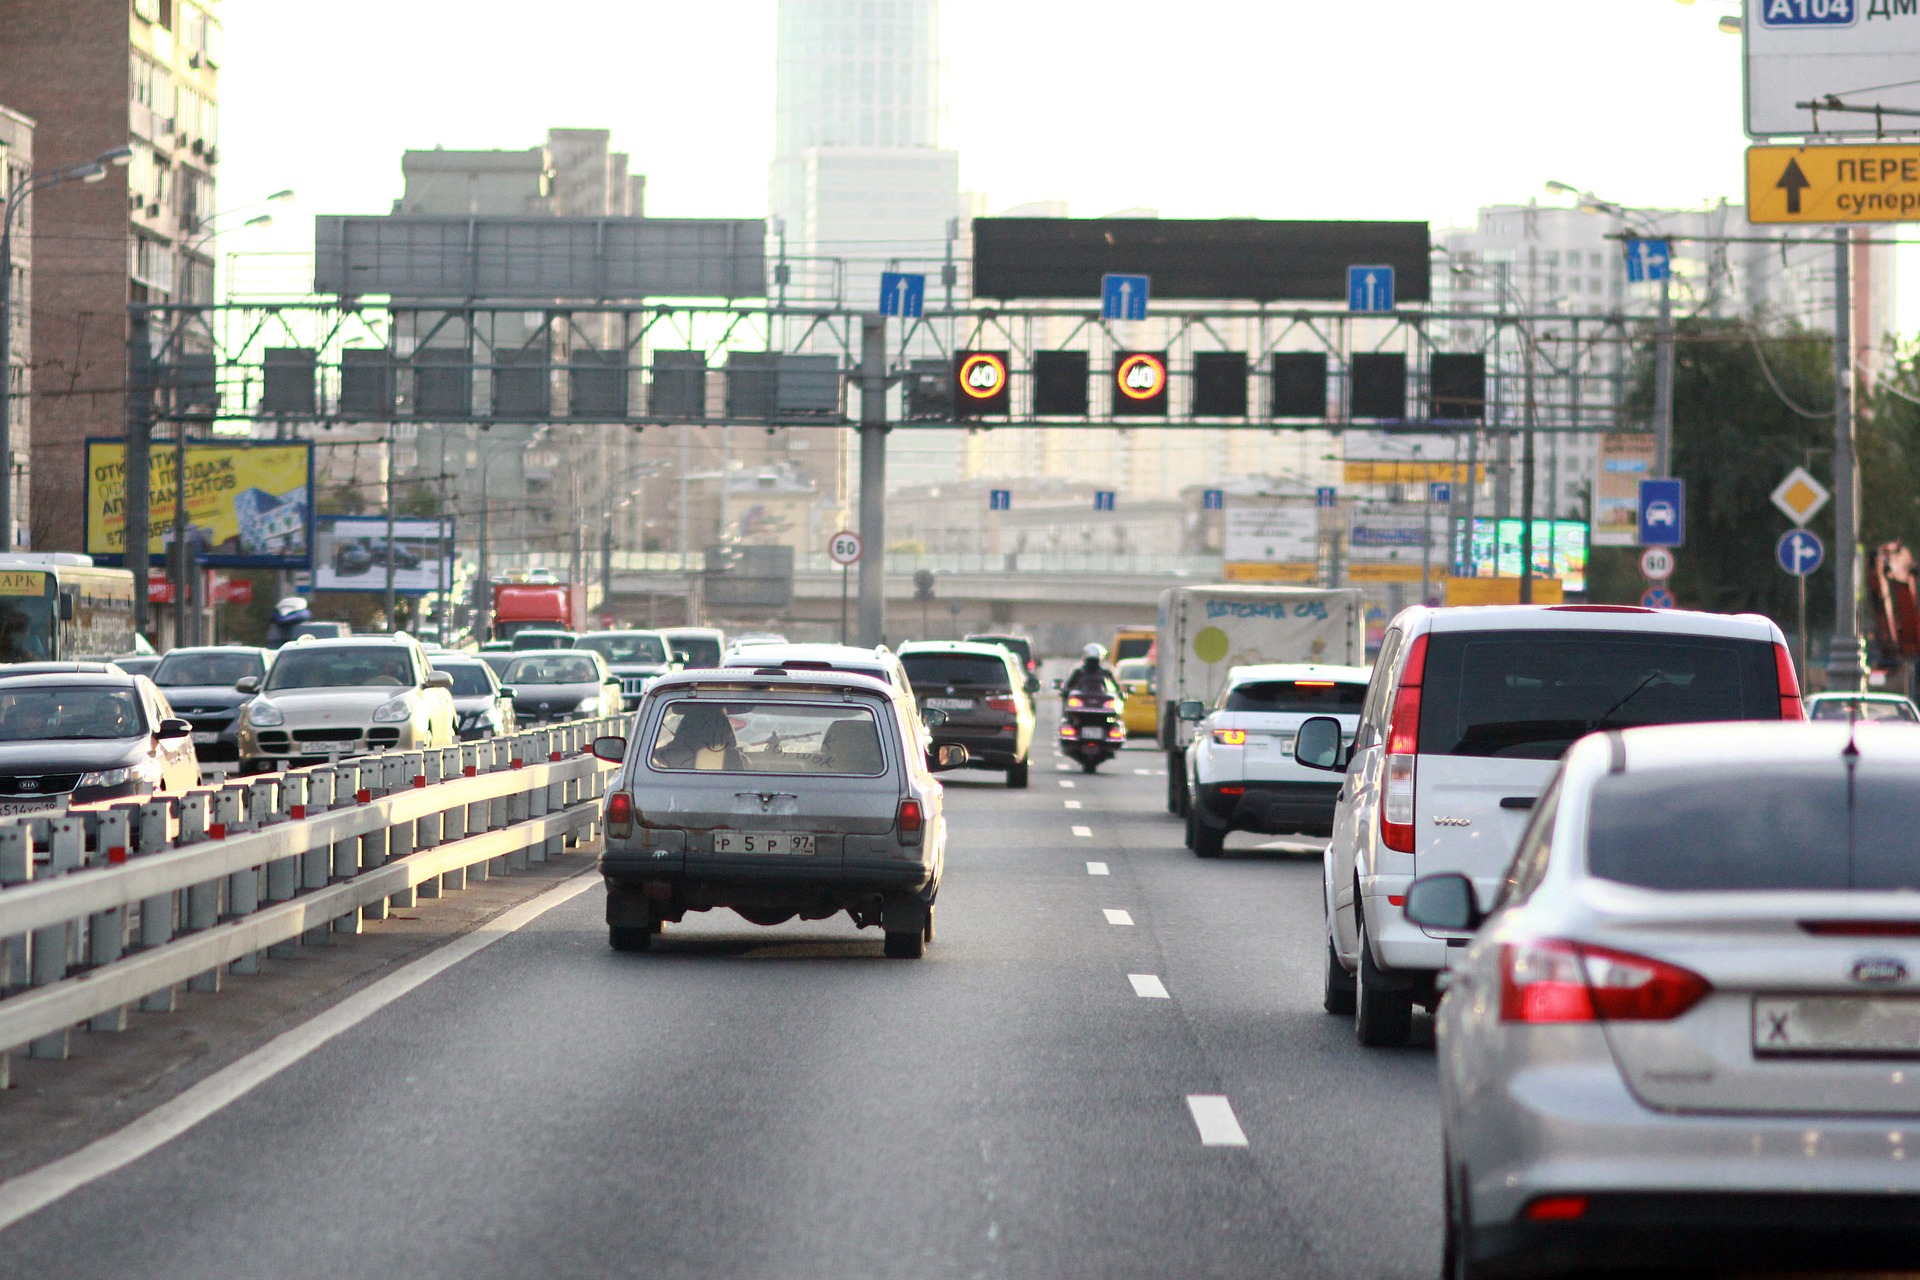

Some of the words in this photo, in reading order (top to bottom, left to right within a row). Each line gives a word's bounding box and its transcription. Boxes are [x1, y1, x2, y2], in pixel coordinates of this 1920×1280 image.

[1837, 158, 1919, 183] ПЕРЕ
[1837, 192, 1920, 216] супер
[103, 474, 236, 517] АПТАМЕНТОВ
[836, 540, 856, 555] 60
[793, 836, 810, 849] 97
